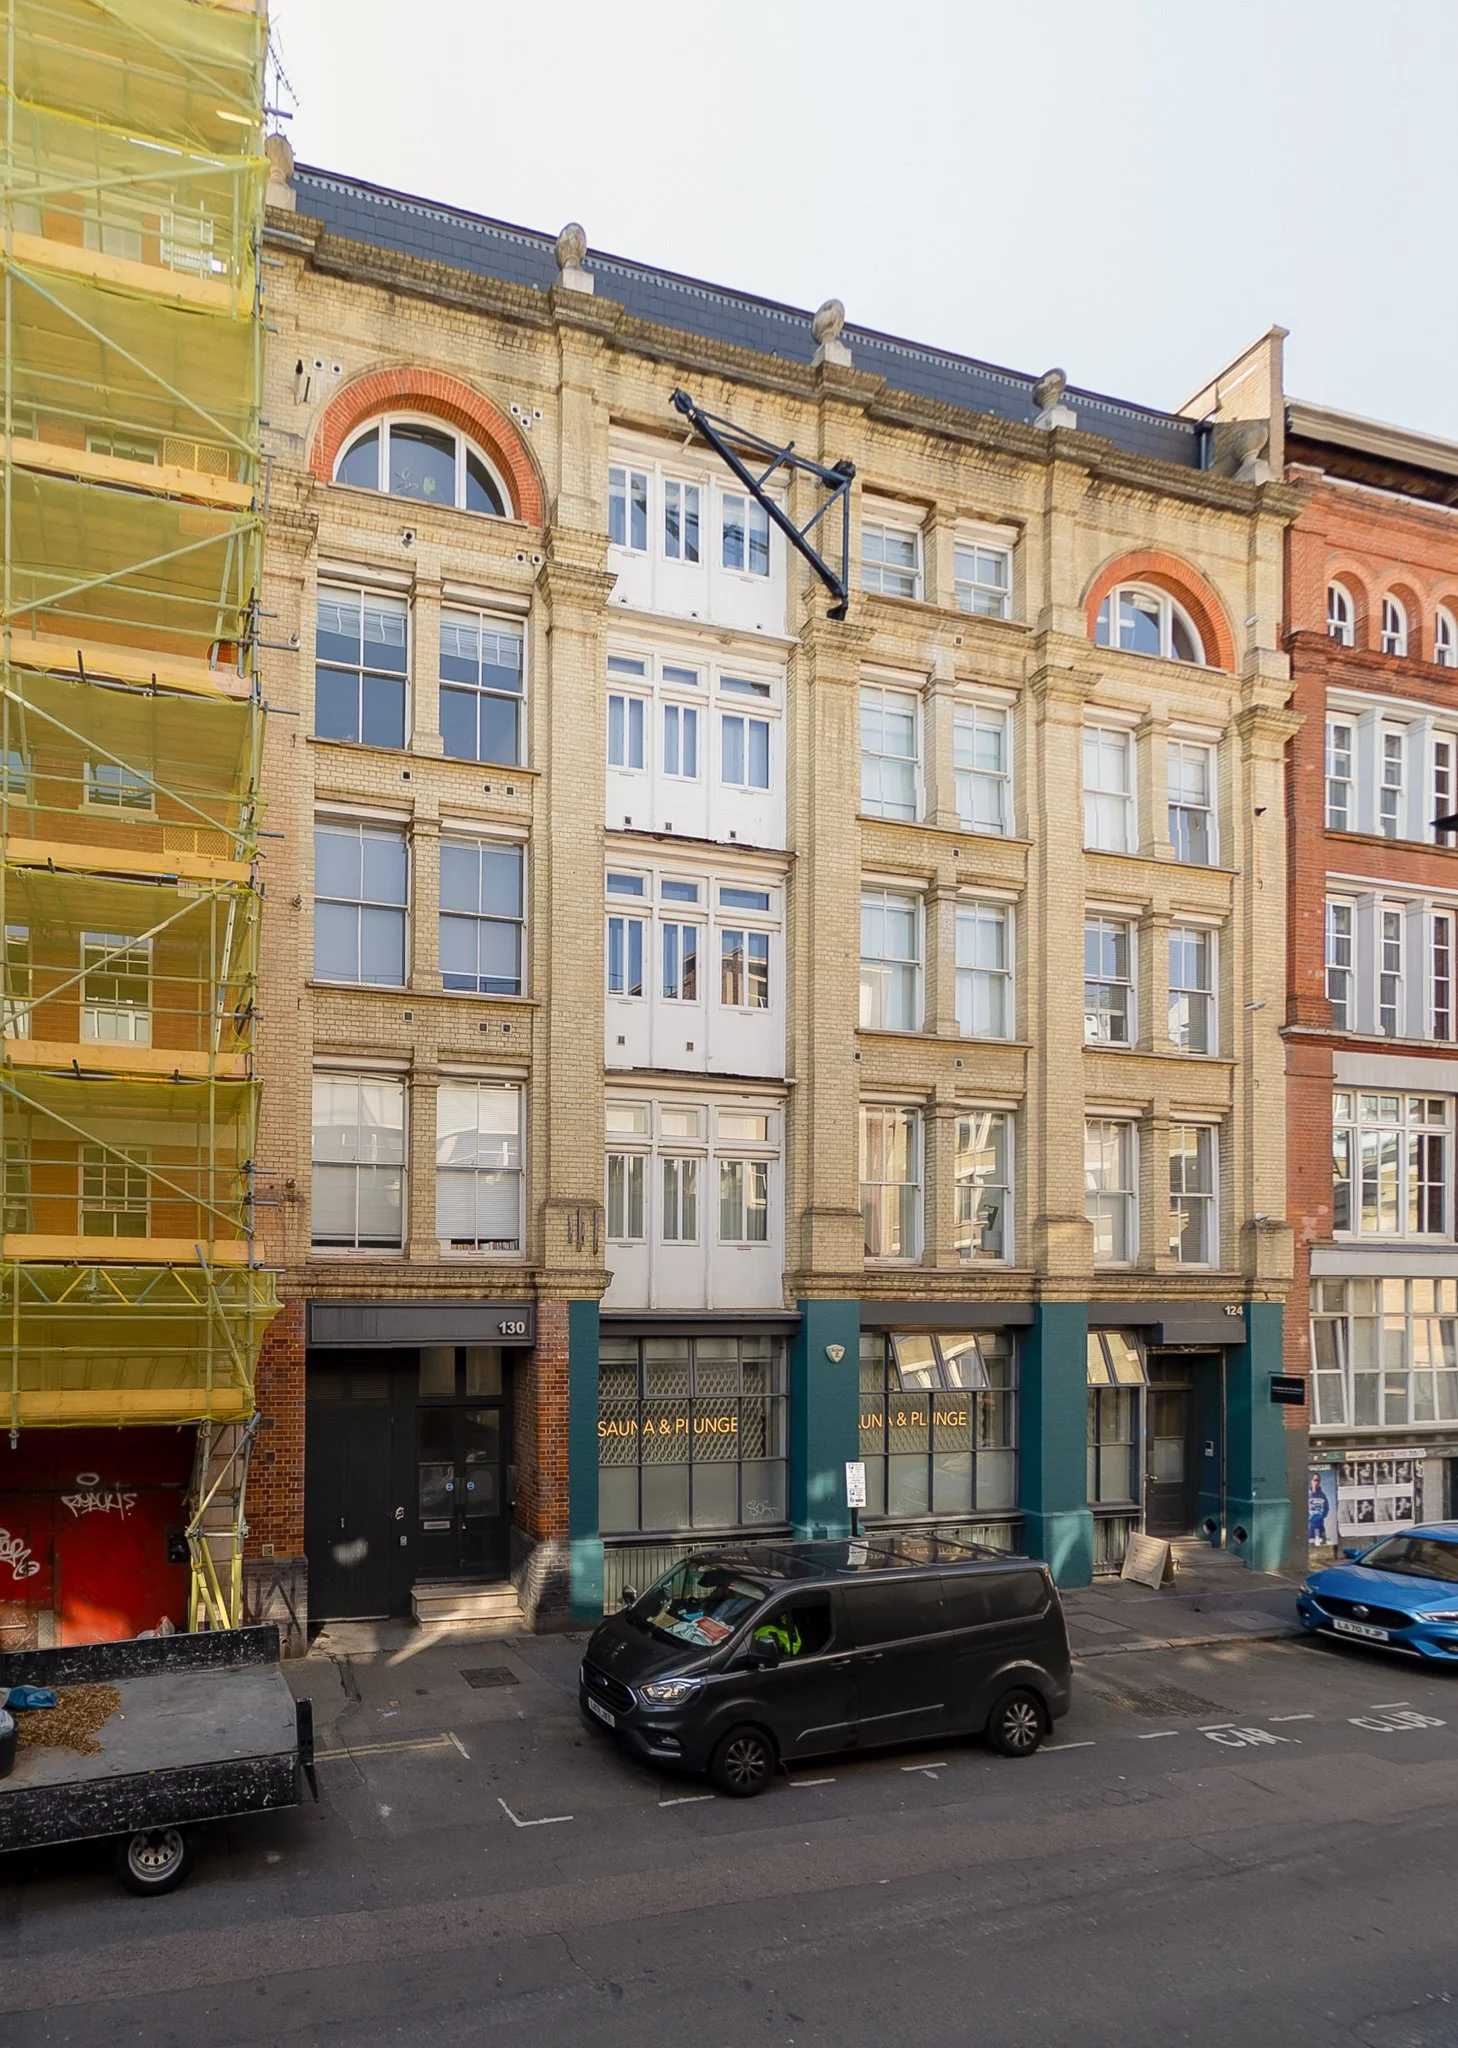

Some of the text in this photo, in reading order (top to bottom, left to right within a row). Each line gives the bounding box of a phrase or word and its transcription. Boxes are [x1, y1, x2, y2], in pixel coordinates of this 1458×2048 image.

[1224, 1305, 1244, 1316] 124
[499, 1321, 526, 1334] 130
[896, 1411, 907, 1426] &
[659, 1418, 671, 1435] &
[1204, 1710, 1447, 1747] CAR CLUB
